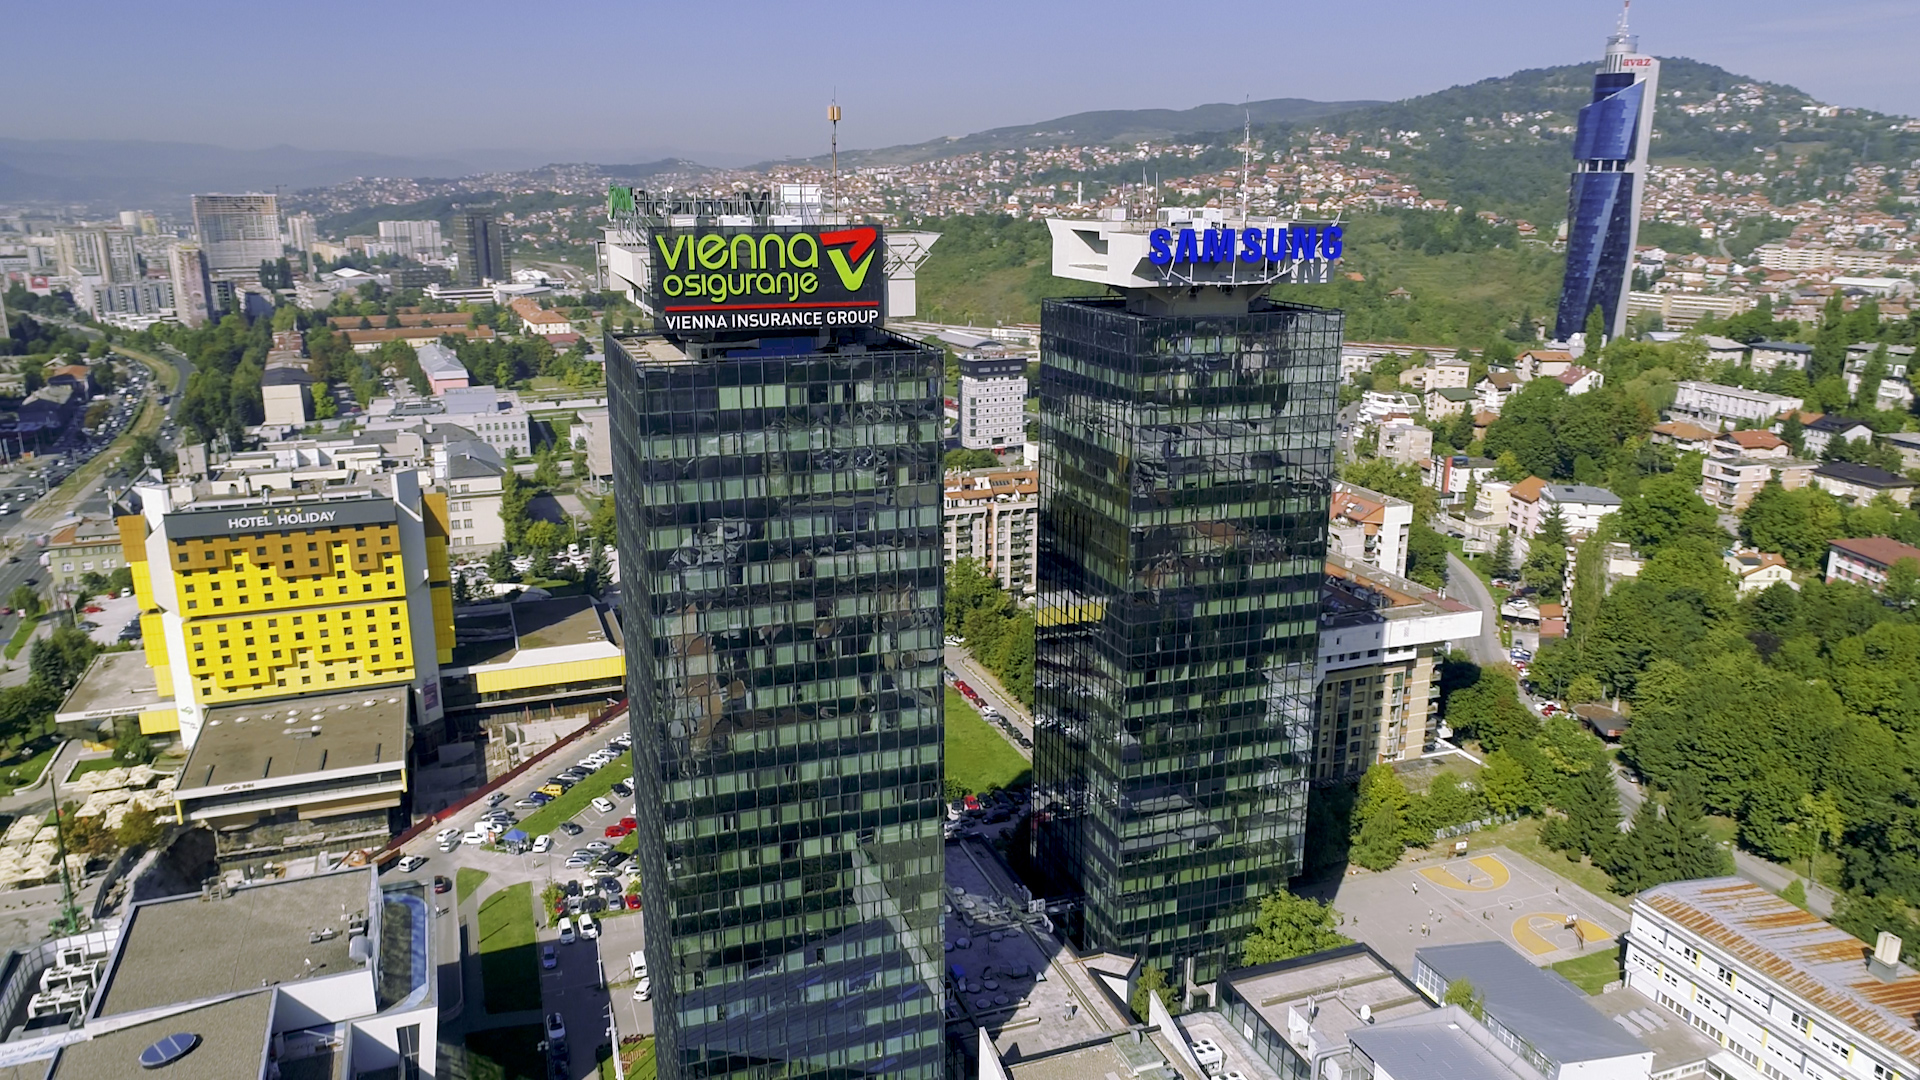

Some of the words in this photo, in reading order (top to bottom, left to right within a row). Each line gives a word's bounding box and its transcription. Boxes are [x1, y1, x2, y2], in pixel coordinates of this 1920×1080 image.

[1623, 58, 1651, 66] avaz
[655, 232, 819, 271] vienna
[1149, 227, 1343, 265] SAMSUNG
[662, 272, 819, 303] osiguranje
[665, 313, 728, 331] VIENNA
[731, 312, 824, 328] INSURANCE
[826, 310, 879, 326] GROUP
[228, 515, 273, 529] HOTEL
[277, 511, 336, 525] HOLIDAY
